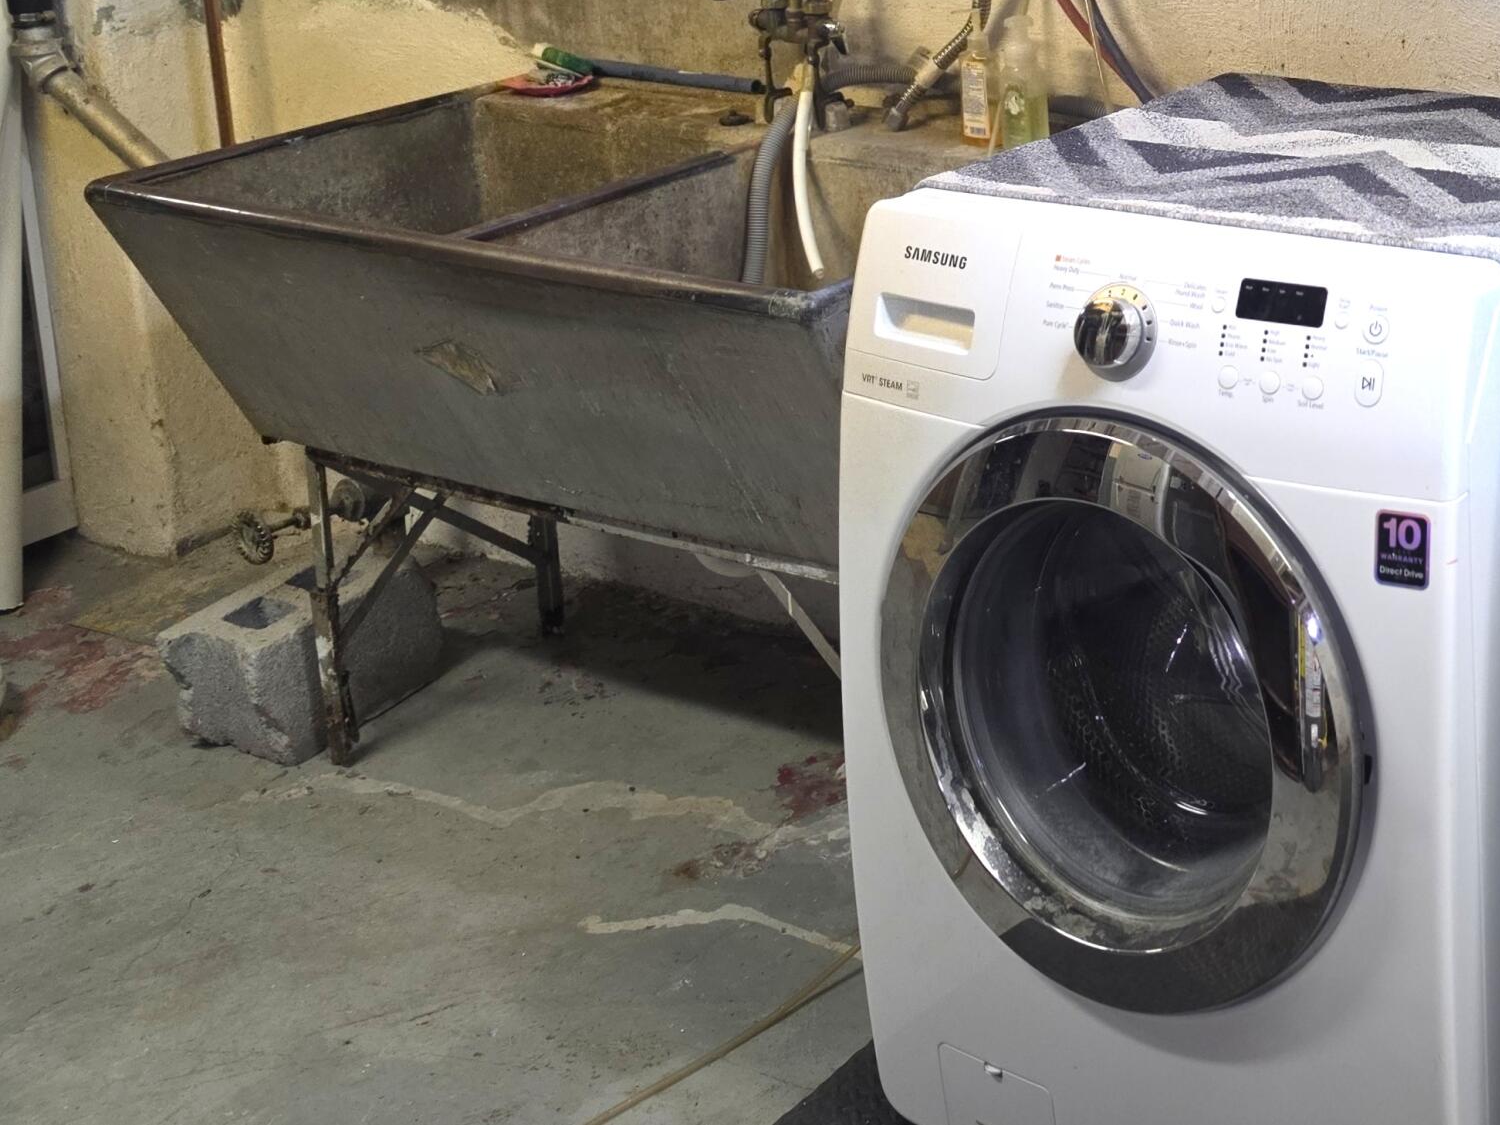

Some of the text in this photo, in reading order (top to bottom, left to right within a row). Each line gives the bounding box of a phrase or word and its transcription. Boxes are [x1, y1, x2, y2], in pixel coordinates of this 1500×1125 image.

[904, 245, 968, 270] SAMSUNG
[879, 377, 903, 391] STEAM
[1383, 517, 1422, 550] 10
[1379, 552, 1424, 564] WARRANTY
[1379, 565, 1424, 579] Direct Drive
